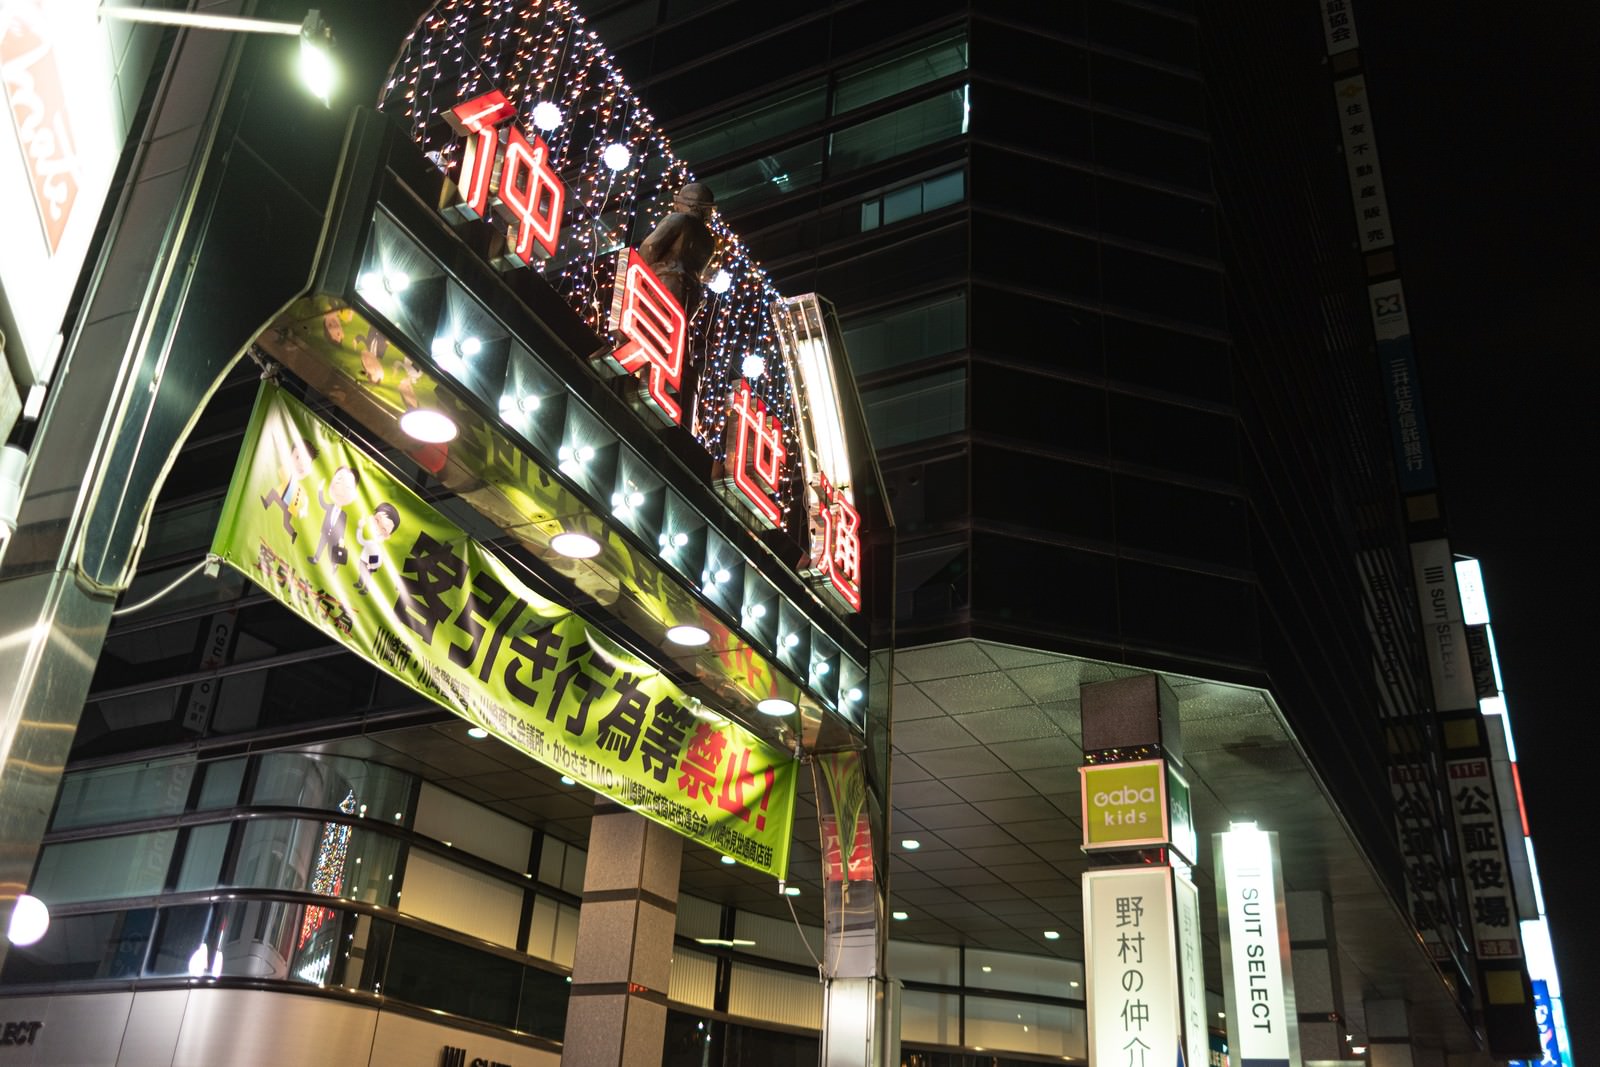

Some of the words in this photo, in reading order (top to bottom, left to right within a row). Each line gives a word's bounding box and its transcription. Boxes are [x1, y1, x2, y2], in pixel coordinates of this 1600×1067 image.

[1345, 103, 1385, 243] 住友不動産販売
[445, 88, 862, 613] 仲見世通
[1389, 358, 1425, 473] 三井住友信託銀行
[1431, 588, 1449, 620] SUIT
[1104, 809, 1147, 827] kids
[1451, 763, 1482, 779] 11F
[1455, 785, 1510, 929] 公証役場
[1242, 888, 1263, 937] SUIT
[1114, 895, 1152, 1067] 野村の仲介
[1246, 944, 1271, 1034] SELECT
